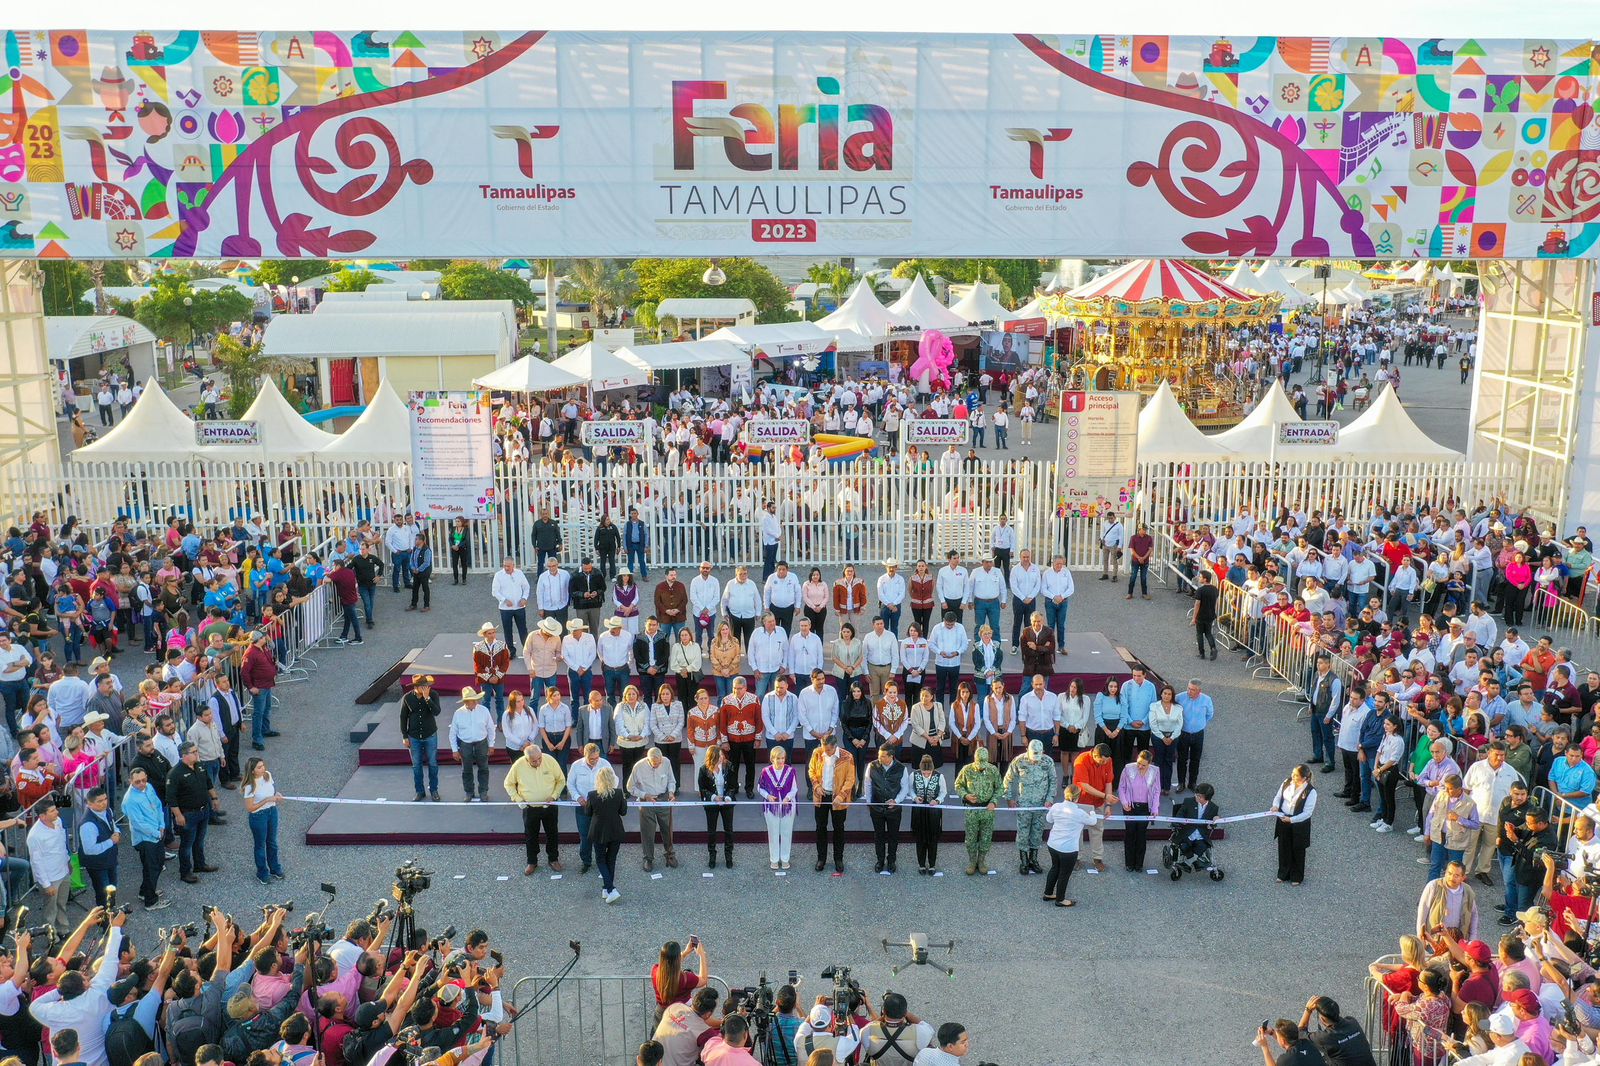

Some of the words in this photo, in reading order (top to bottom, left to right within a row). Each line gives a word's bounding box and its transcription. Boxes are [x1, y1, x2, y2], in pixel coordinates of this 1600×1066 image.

[672, 76, 893, 172] Feria
[27, 125, 53, 141] 20
[29, 142, 55, 159] 23
[478, 184, 576, 202] Tamaulipas
[660, 185, 907, 215] TAMAULIPAS
[989, 184, 1084, 203] Tamaulipas
[760, 223, 808, 239] 2023
[1069, 394, 1078, 410] 1
[1088, 402, 1119, 410] principal
[416, 416, 482, 424] Recomendaciones
[204, 428, 251, 436] ENTRADA
[593, 427, 636, 438] SALIDA
[756, 426, 798, 437] SALIDA
[916, 426, 957, 436] SALIDA
[1286, 428, 1330, 437] ENTRADA
